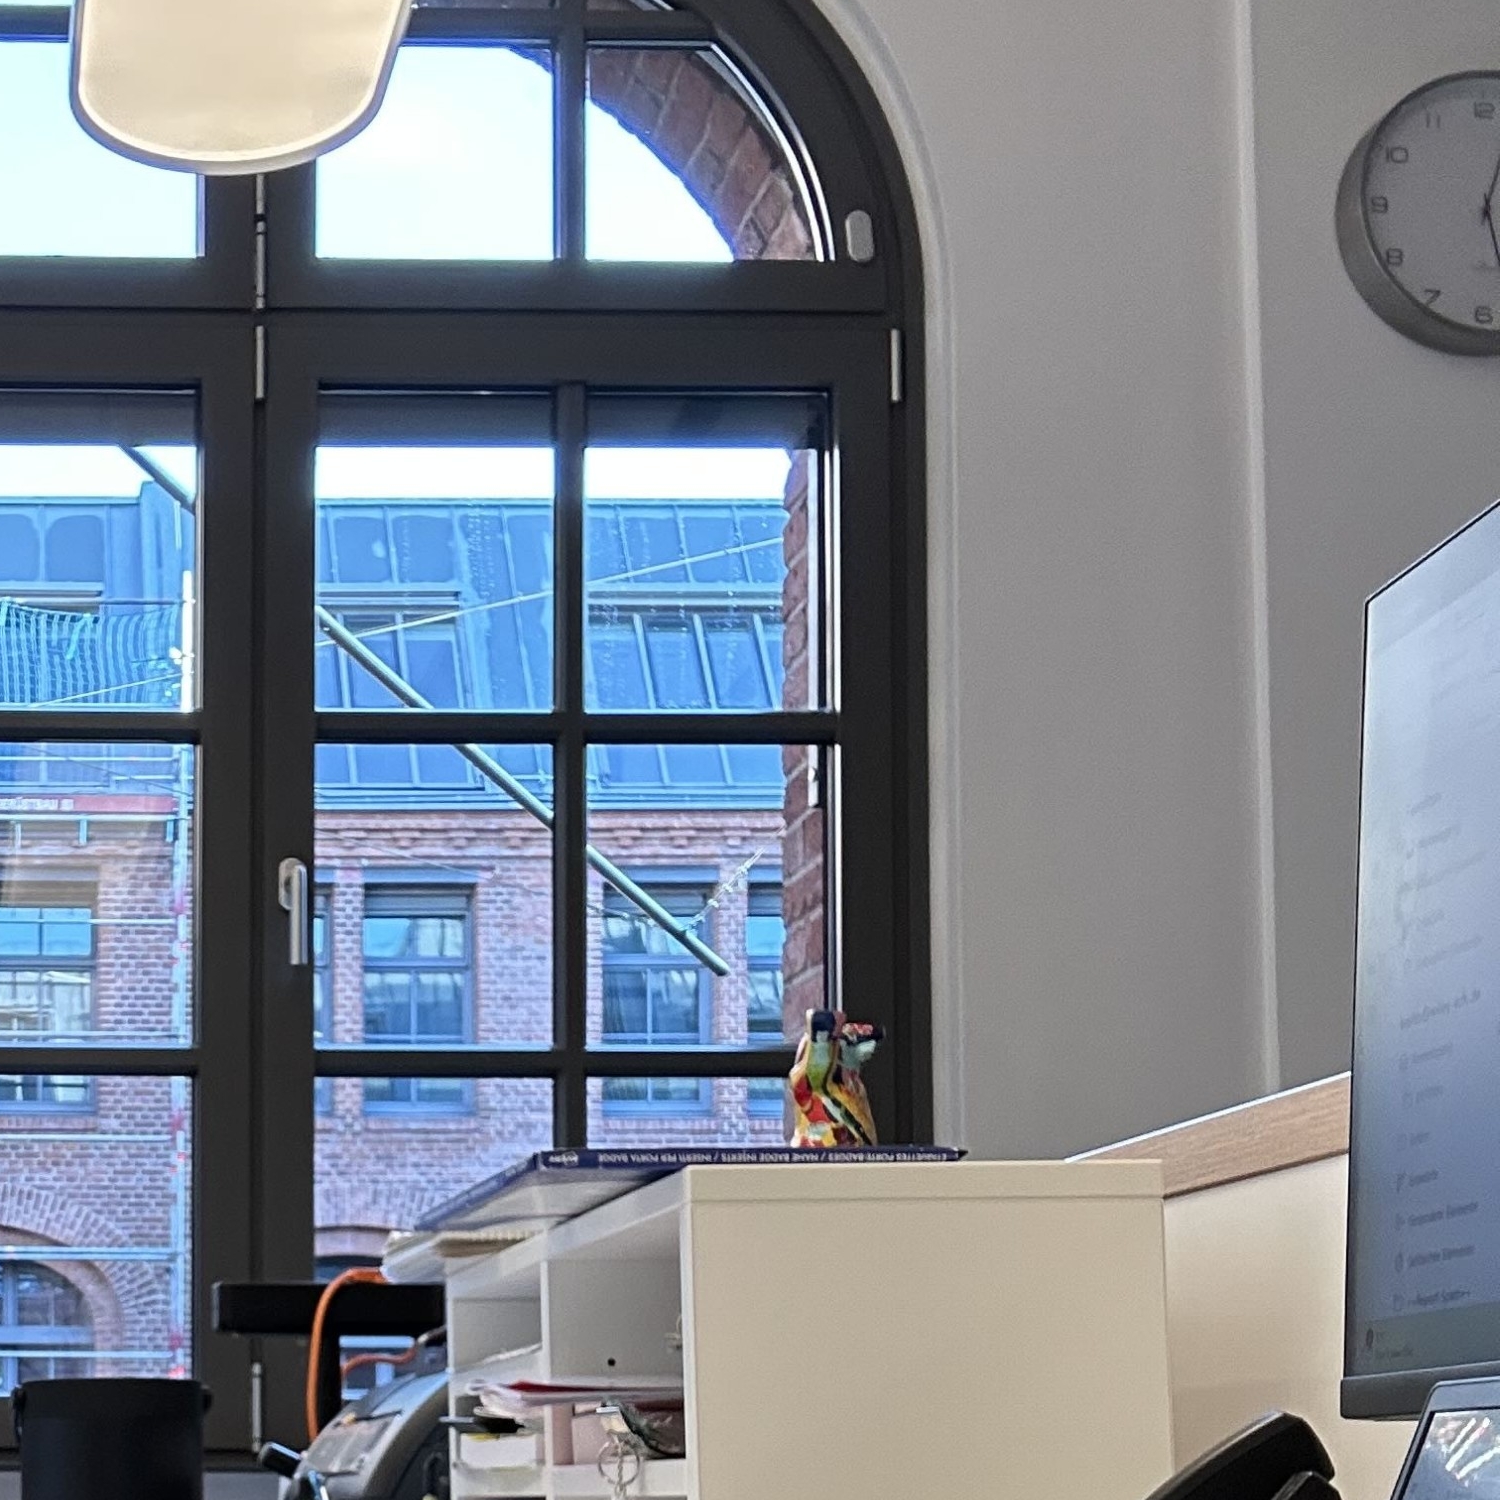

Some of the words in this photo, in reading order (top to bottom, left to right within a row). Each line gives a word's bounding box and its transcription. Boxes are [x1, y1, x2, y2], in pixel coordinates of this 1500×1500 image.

[1425, 112, 1441, 129] 11
[1386, 146, 1409, 164] 10
[1371, 196, 1389, 214] 9
[1386, 248, 1404, 266] 8
[1424, 289, 1442, 306] 7
[1473, 306, 1493, 325] 6
